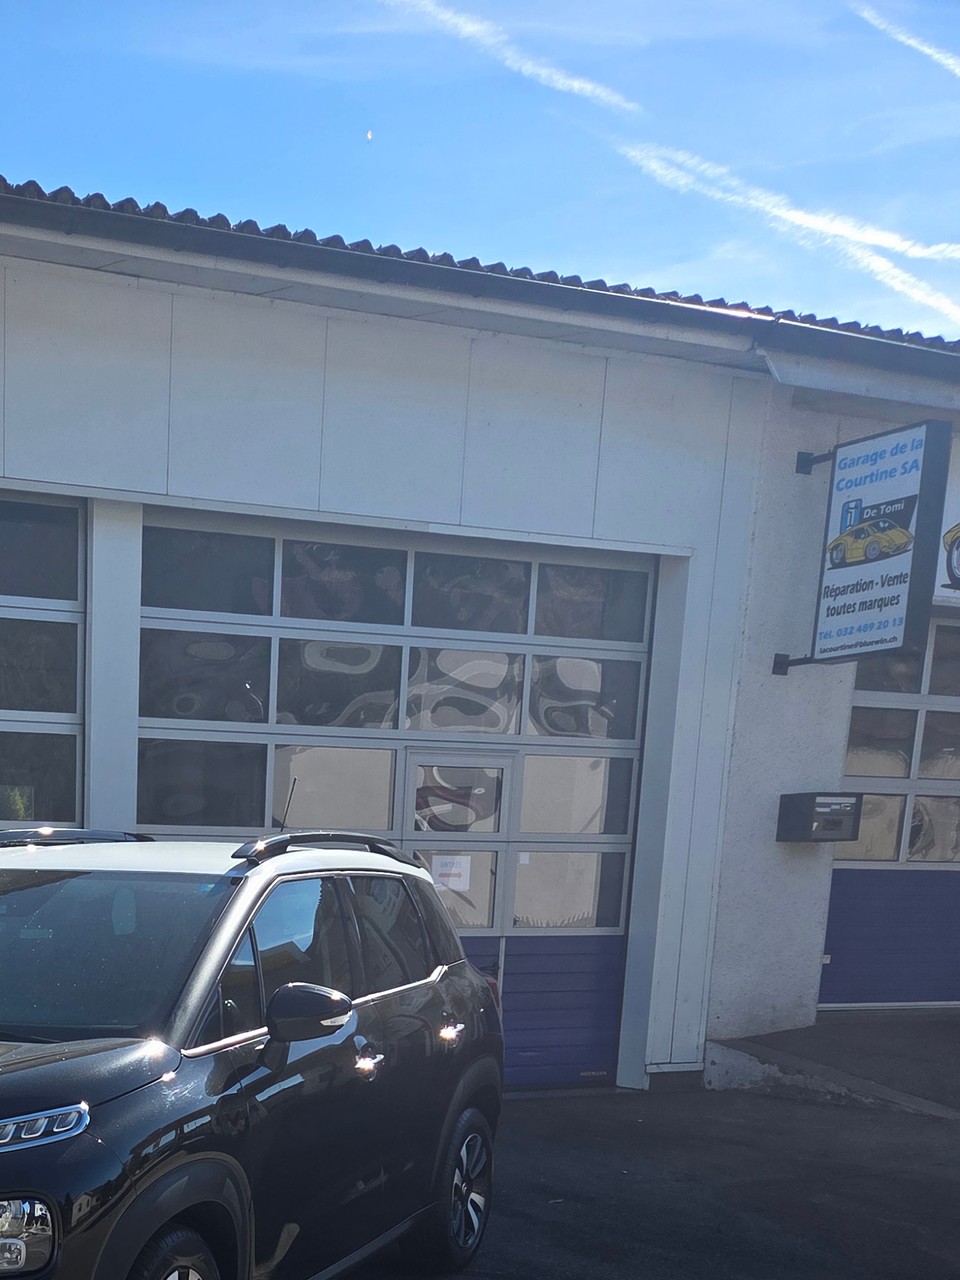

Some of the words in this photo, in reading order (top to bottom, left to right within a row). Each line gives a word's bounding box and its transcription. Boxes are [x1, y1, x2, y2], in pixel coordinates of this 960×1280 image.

[837, 448, 887, 471] Garage
[890, 442, 908, 457] de
[910, 437, 924, 451] la
[835, 467, 897, 492] Courtine
[900, 458, 920, 476] SA
[863, 508, 878, 519] De
[879, 500, 905, 515] Tomi
[823, 578, 874, 601] Réparation
[880, 571, 909, 588] Vente
[826, 600, 856, 618] toutes
[858, 594, 901, 612] marques
[818, 630, 834, 640] Tél.
[836, 626, 854, 637] 032
[856, 622, 875, 633] 489
[876, 619, 889, 630] 20
[892, 616, 904, 627] 13
